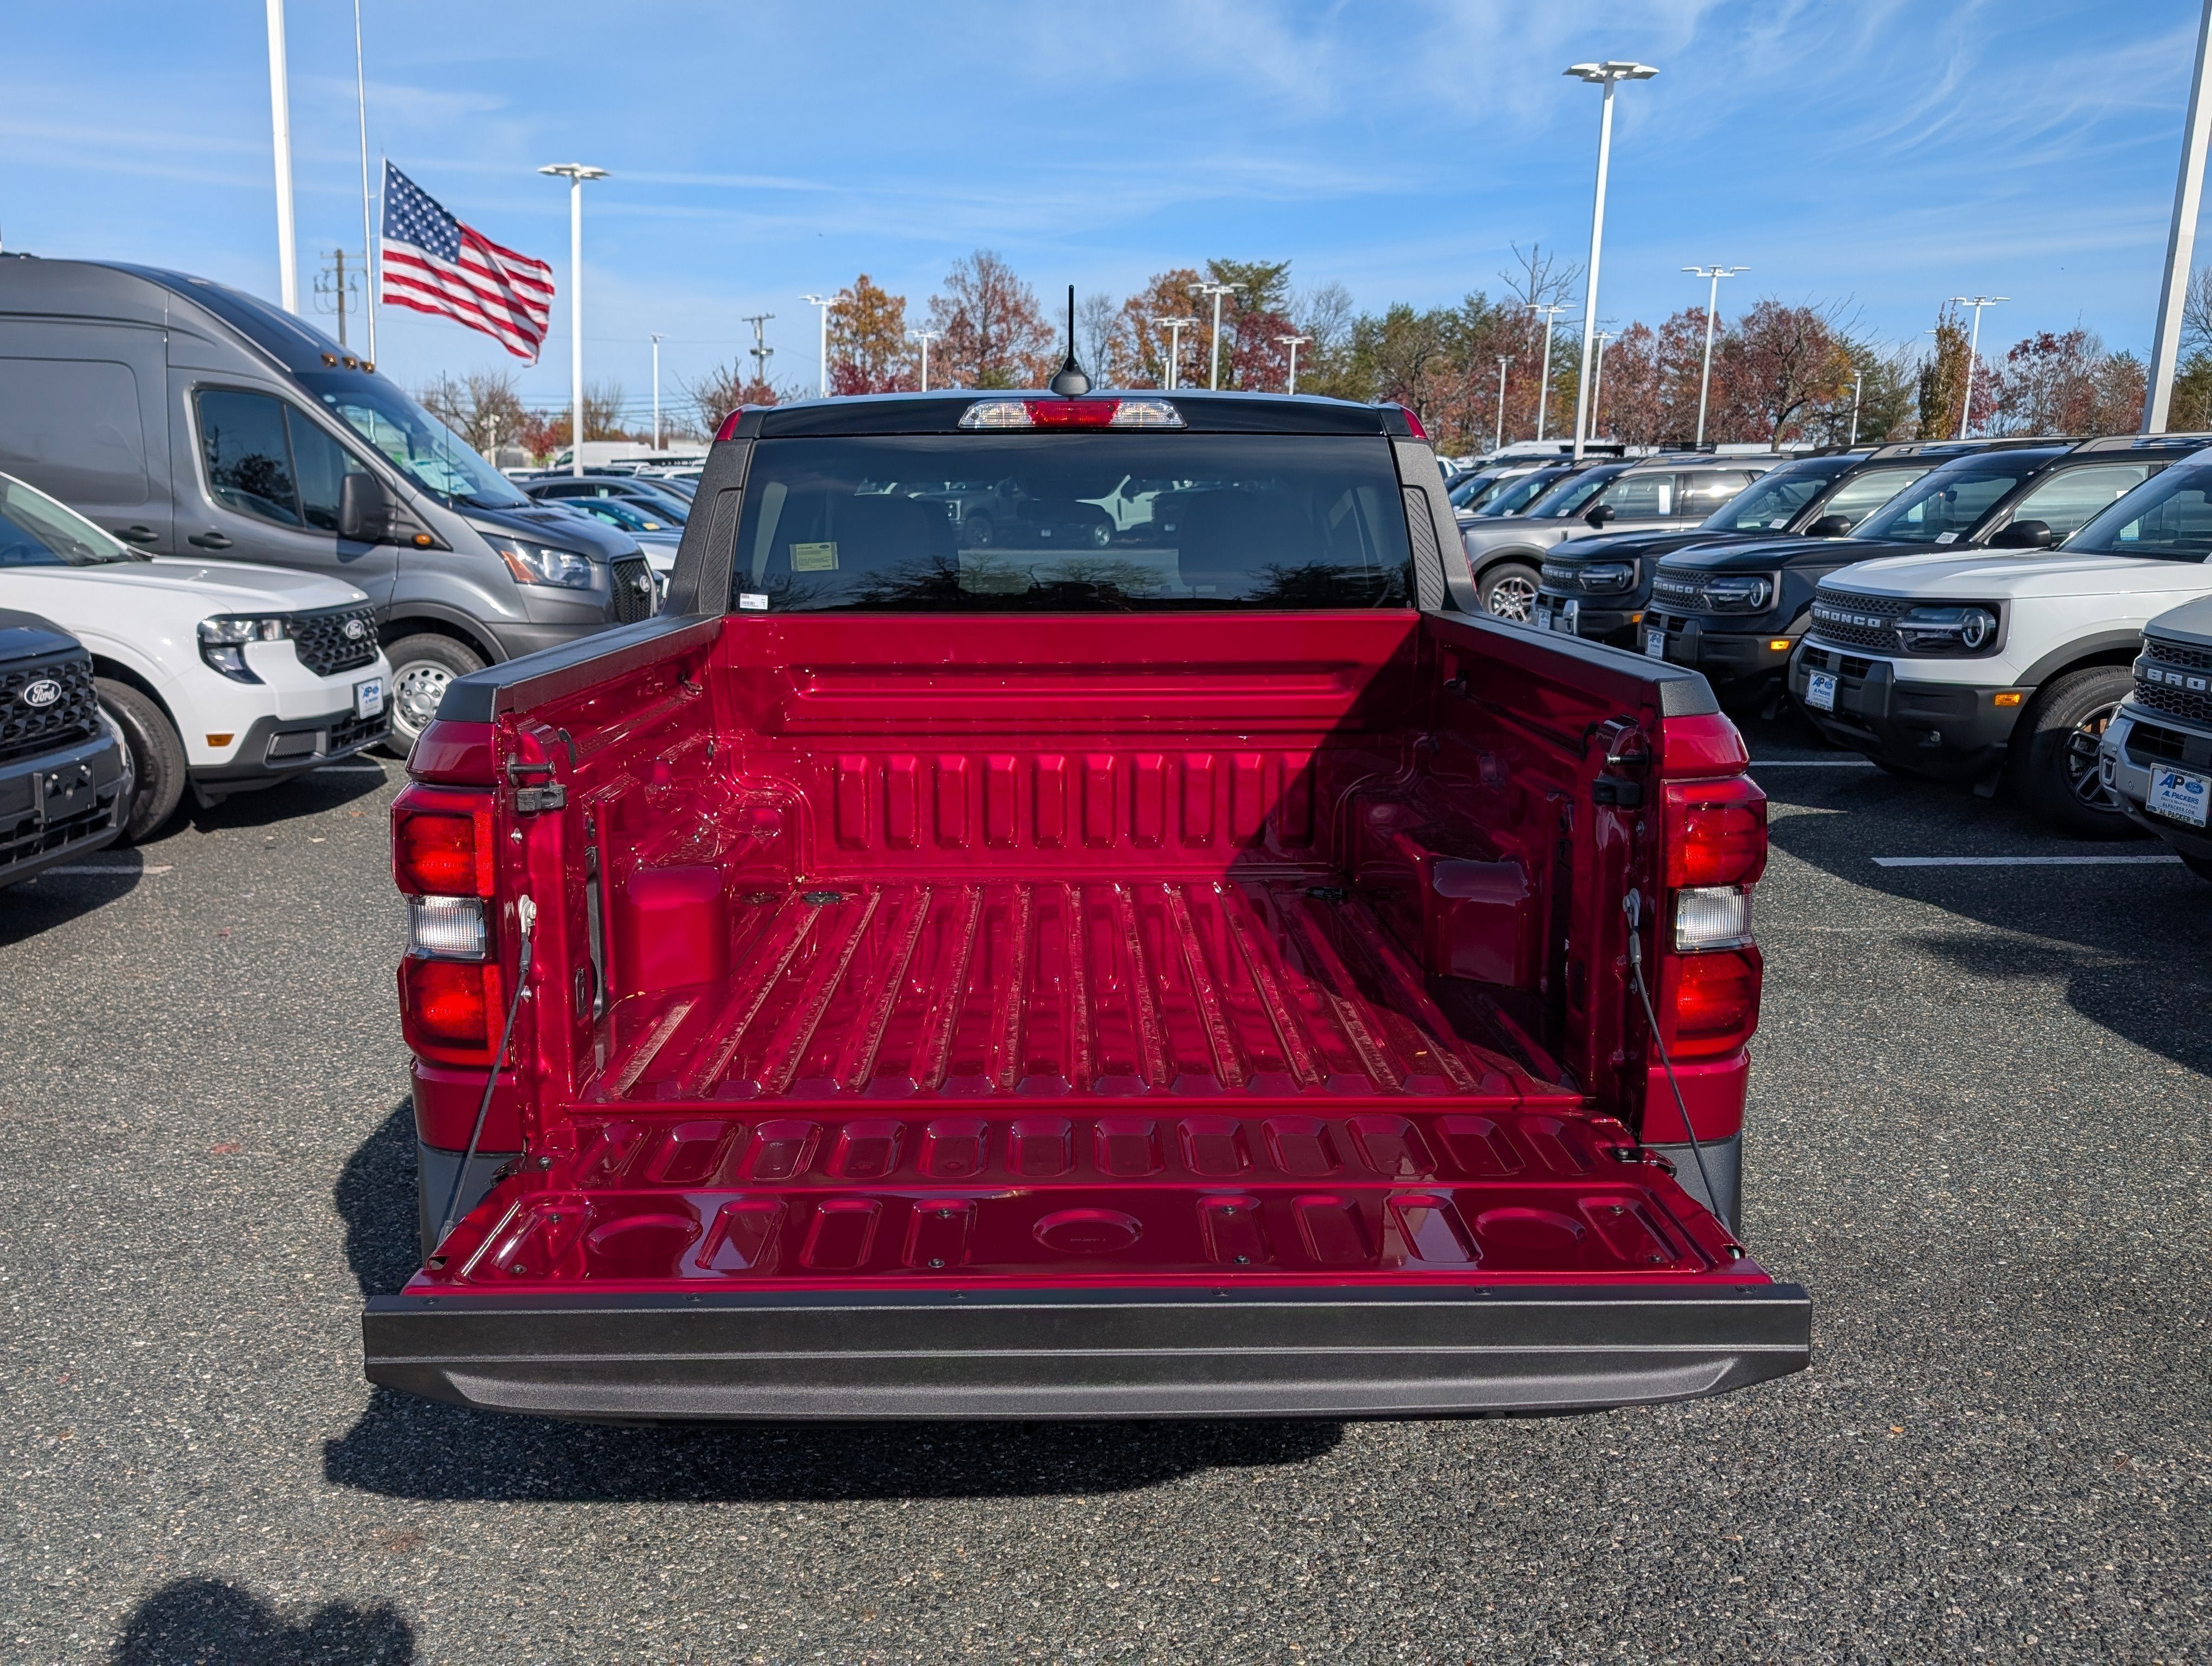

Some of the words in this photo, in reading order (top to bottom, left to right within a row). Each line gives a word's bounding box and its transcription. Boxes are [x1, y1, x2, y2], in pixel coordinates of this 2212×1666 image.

[1814, 608, 1881, 628] BRONCO
[1812, 676, 1825, 688] AP
[2147, 668, 2212, 693] BRO
[32, 683, 55, 703] Ford
[363, 686, 372, 700] AP
[2158, 773, 2185, 789] AP
[2163, 802, 2195, 815] ALPACKER.COM
